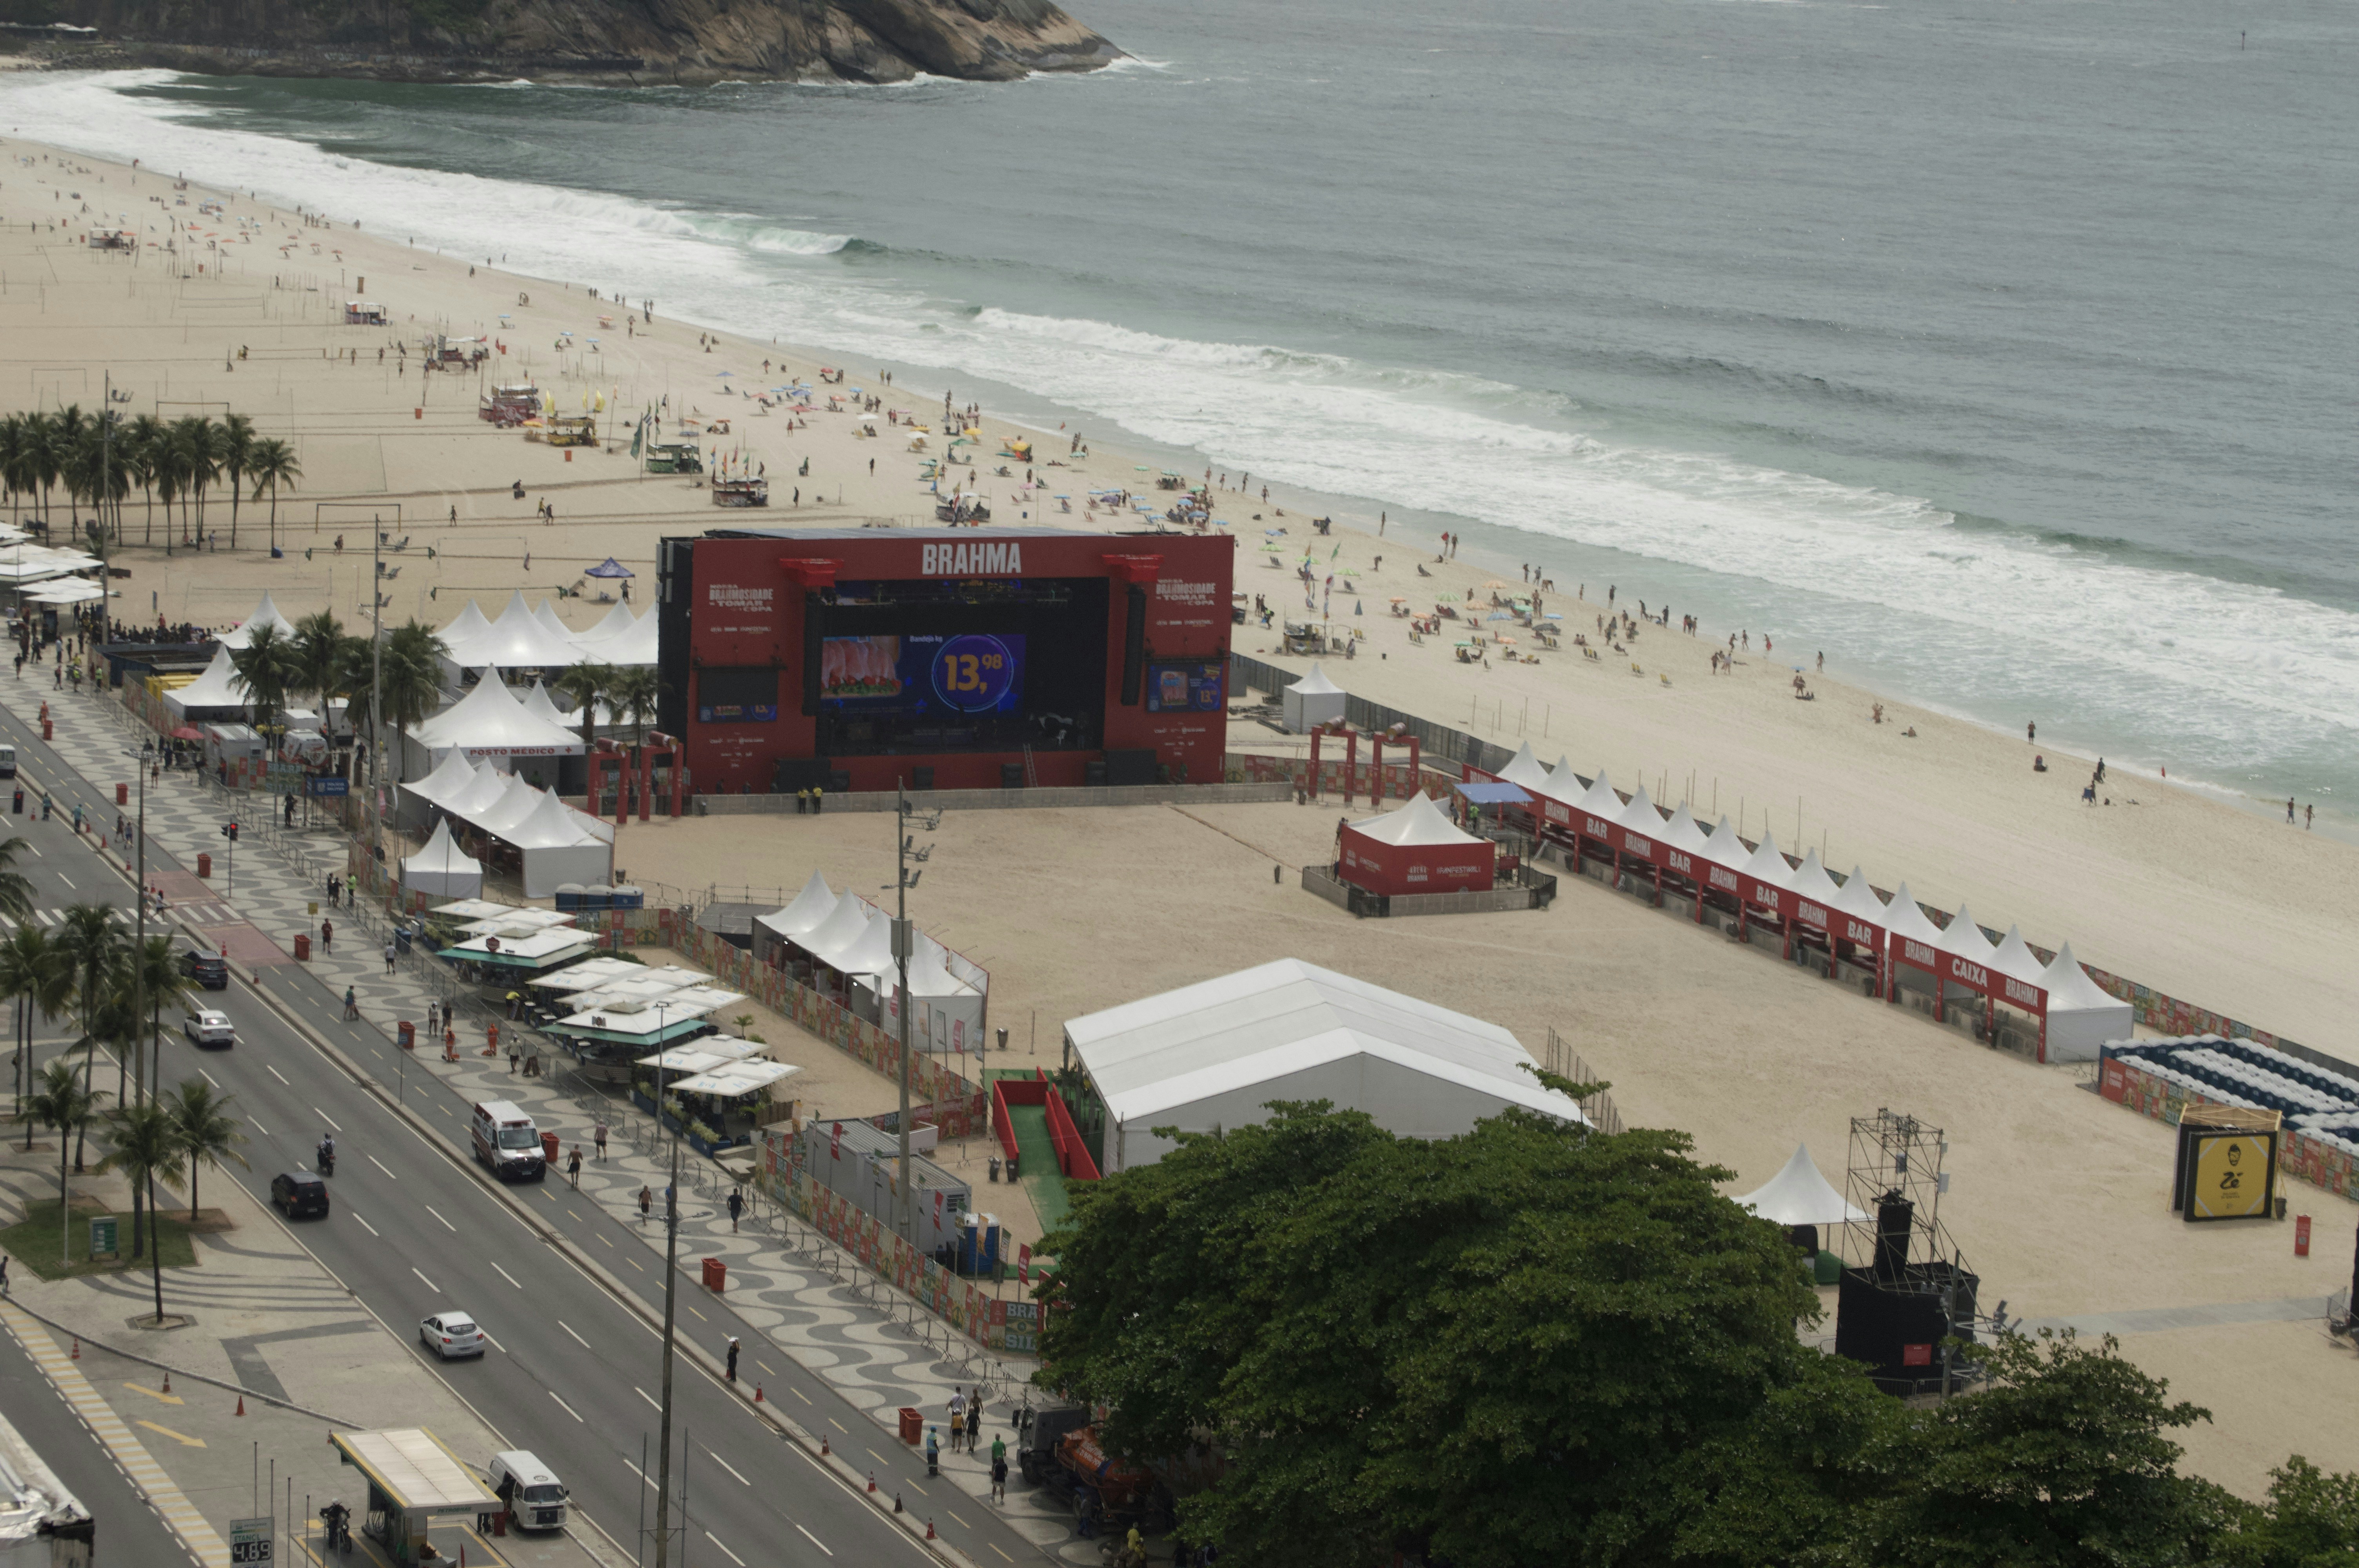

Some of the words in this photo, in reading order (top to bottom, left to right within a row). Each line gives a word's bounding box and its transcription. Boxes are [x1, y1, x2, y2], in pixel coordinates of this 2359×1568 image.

[922, 543, 1021, 575] BRAHMA
[471, 748, 507, 756] POSTO
[511, 747, 555, 755] MÉDICO
[1545, 800, 1569, 825] BRAHMA
[1587, 817, 1608, 839] BAR
[1625, 832, 1651, 858] BRAHMA
[1669, 850, 1691, 874] BAR
[1710, 865, 1737, 892] BRAHMA
[1756, 884, 1779, 909] BAR
[1798, 900, 1827, 929] BRAHMA
[1847, 920, 1872, 946] BAR
[1905, 940, 1936, 968] BRAHMA
[1952, 957, 1988, 987] CAIXA
[2006, 978, 2038, 1007] BRAHMA
[885, 1112, 900, 1126] BR
[1007, 1303, 1038, 1318] BRA
[1005, 1334, 1036, 1350] SIL
